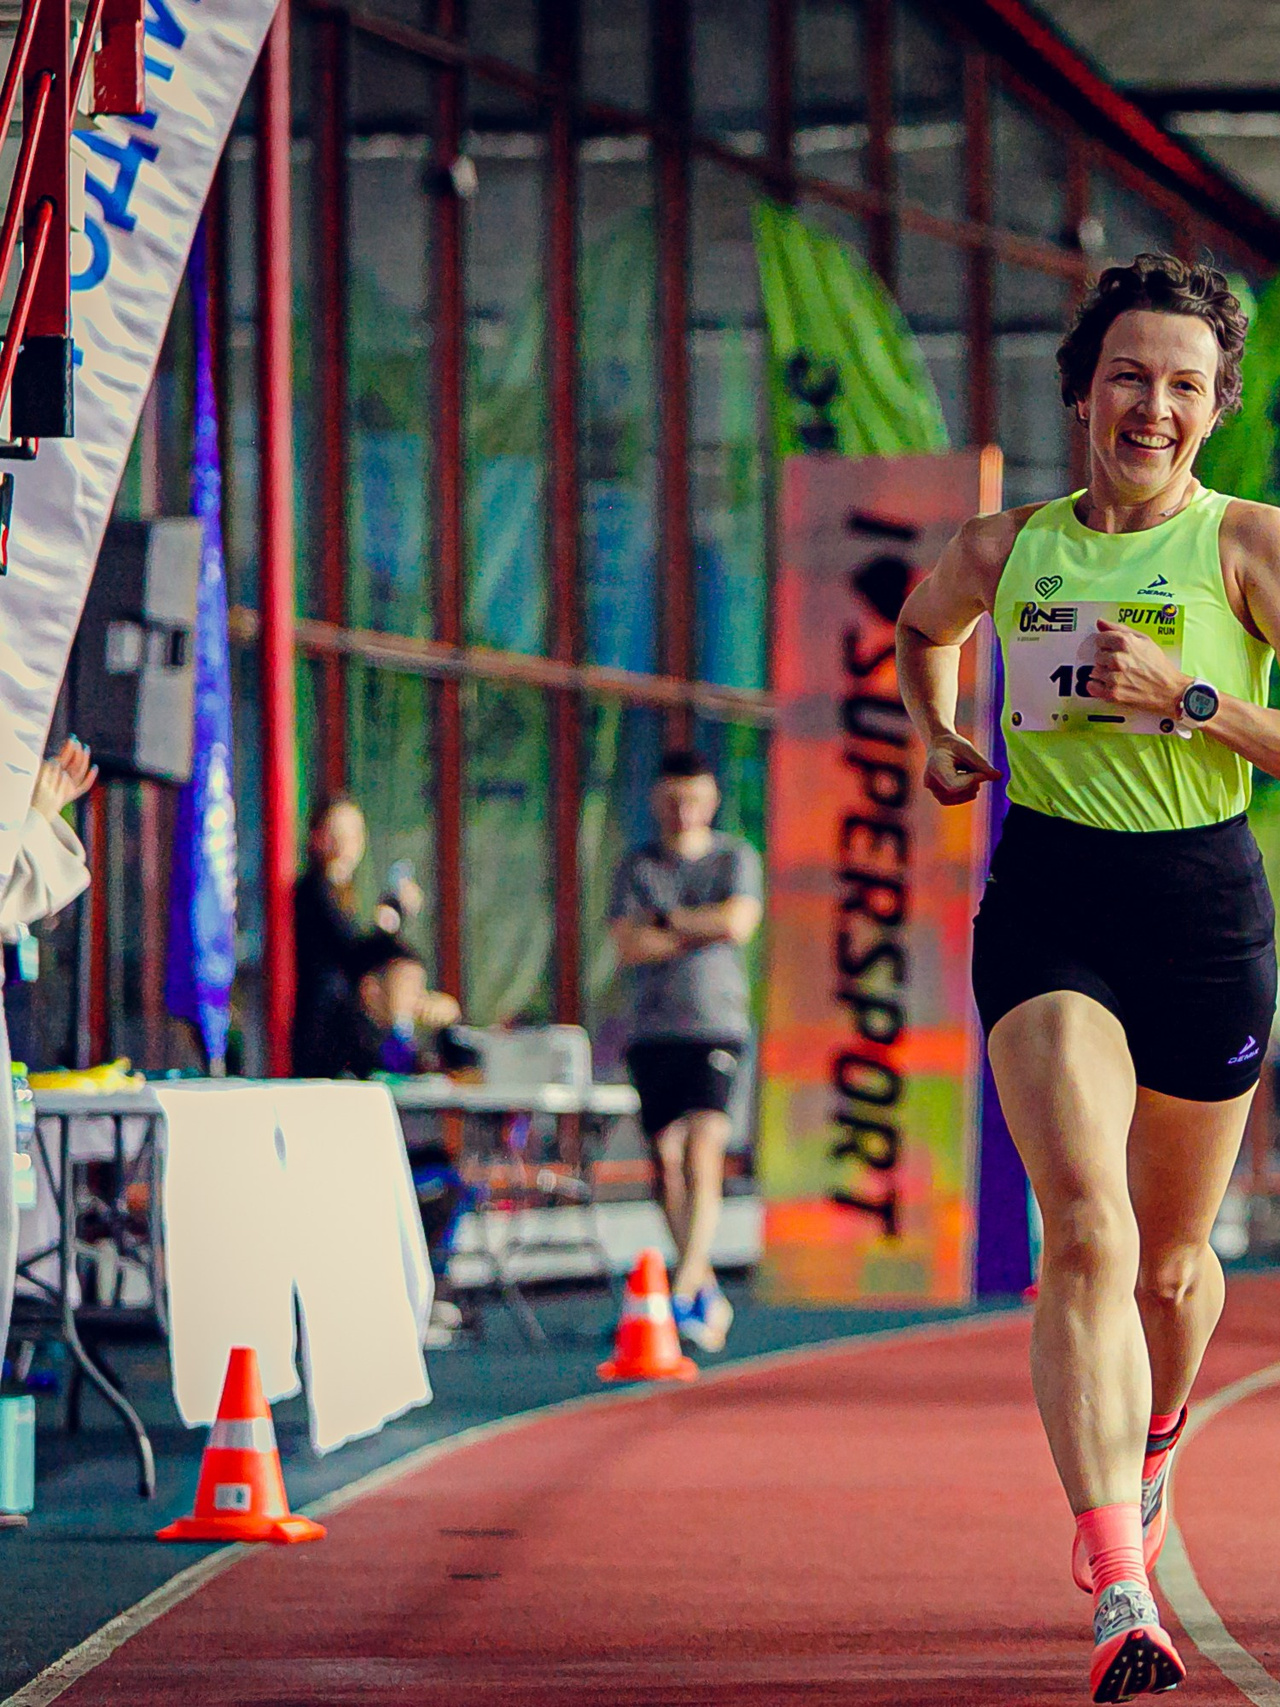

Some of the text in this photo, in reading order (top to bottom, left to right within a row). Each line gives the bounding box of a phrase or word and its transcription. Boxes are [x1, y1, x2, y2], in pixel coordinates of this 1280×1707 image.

[1136, 588, 1175, 599] DEMIX
[1030, 623, 1074, 633] MILE
[1157, 626, 1176, 636] RUN
[832, 622, 912, 1238] SUPERSPORT
